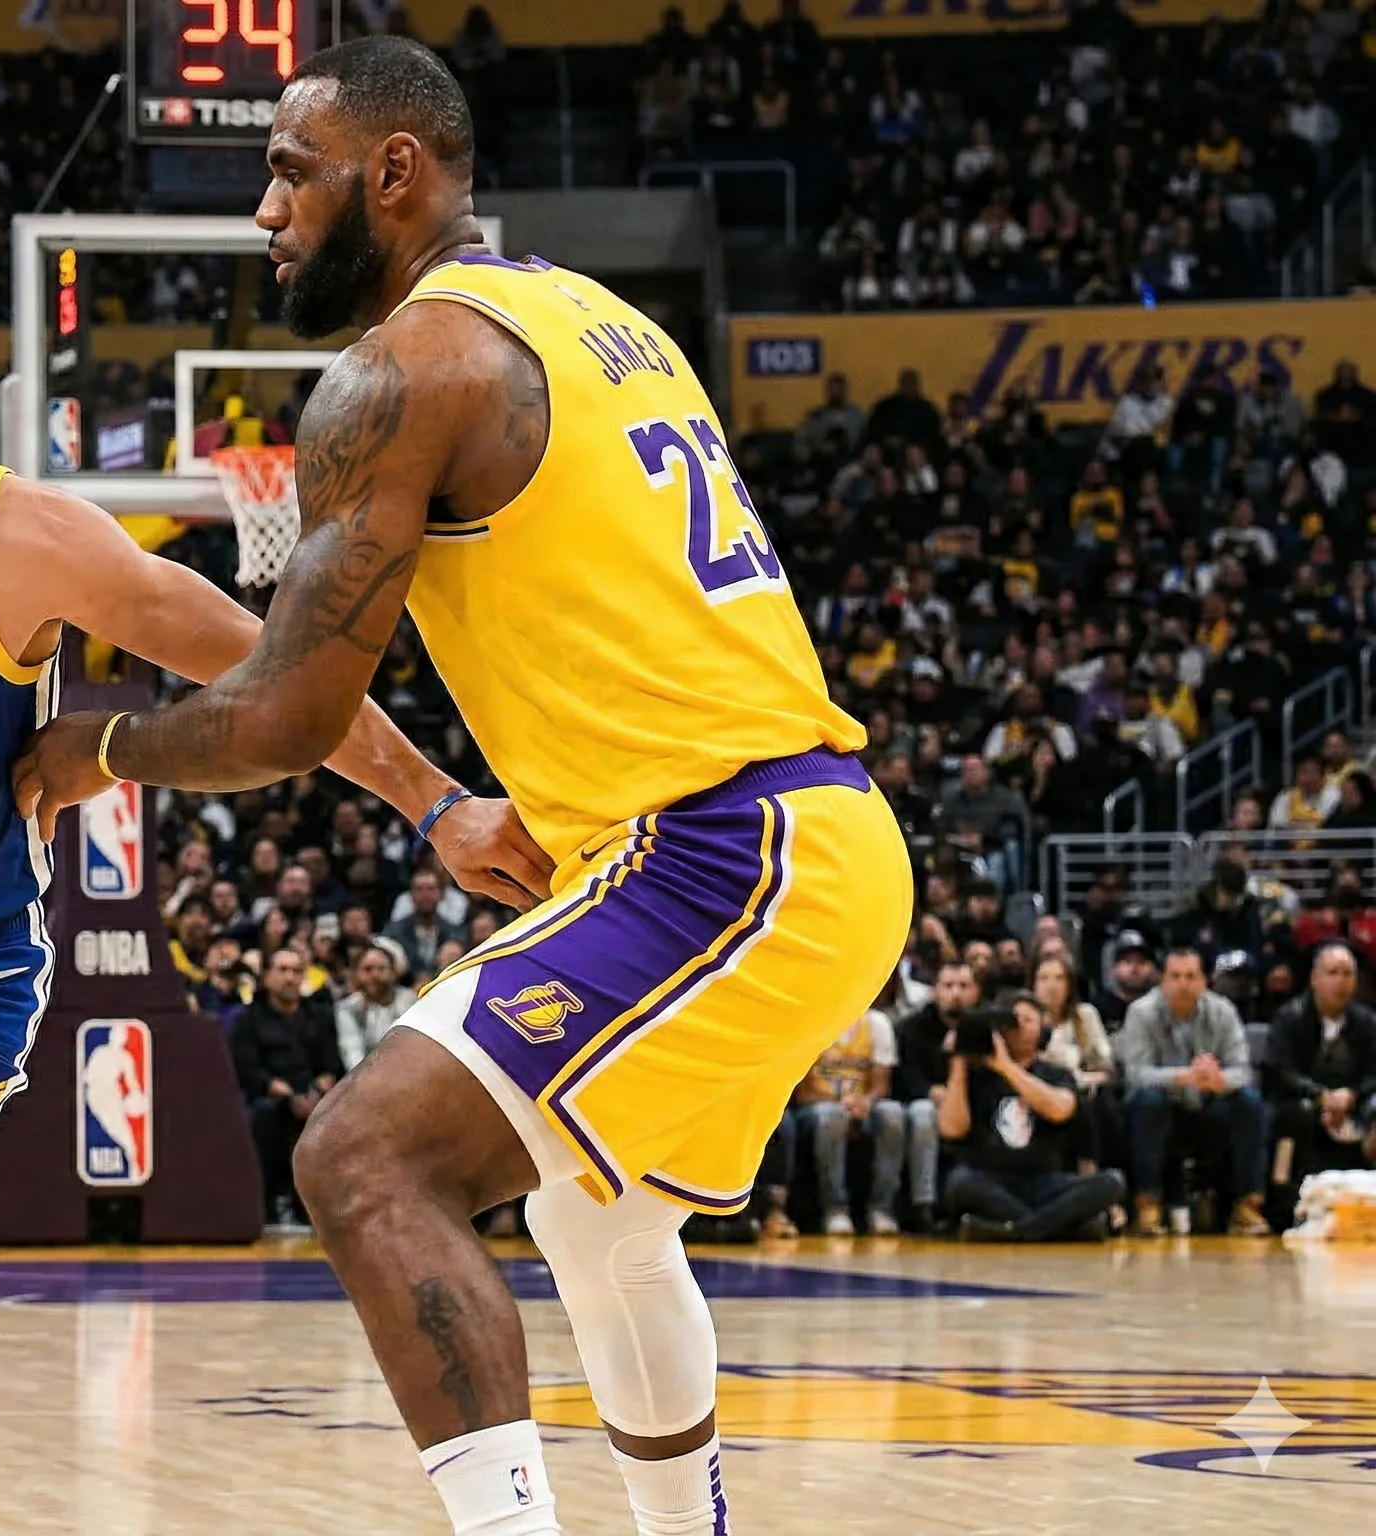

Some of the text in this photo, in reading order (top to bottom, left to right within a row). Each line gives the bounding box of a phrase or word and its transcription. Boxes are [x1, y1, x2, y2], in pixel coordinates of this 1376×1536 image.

[192, 99, 276, 126] TISS
[578, 322, 675, 386] JAMES
[624, 415, 787, 606] 23
[74, 929, 152, 977] @NBA
